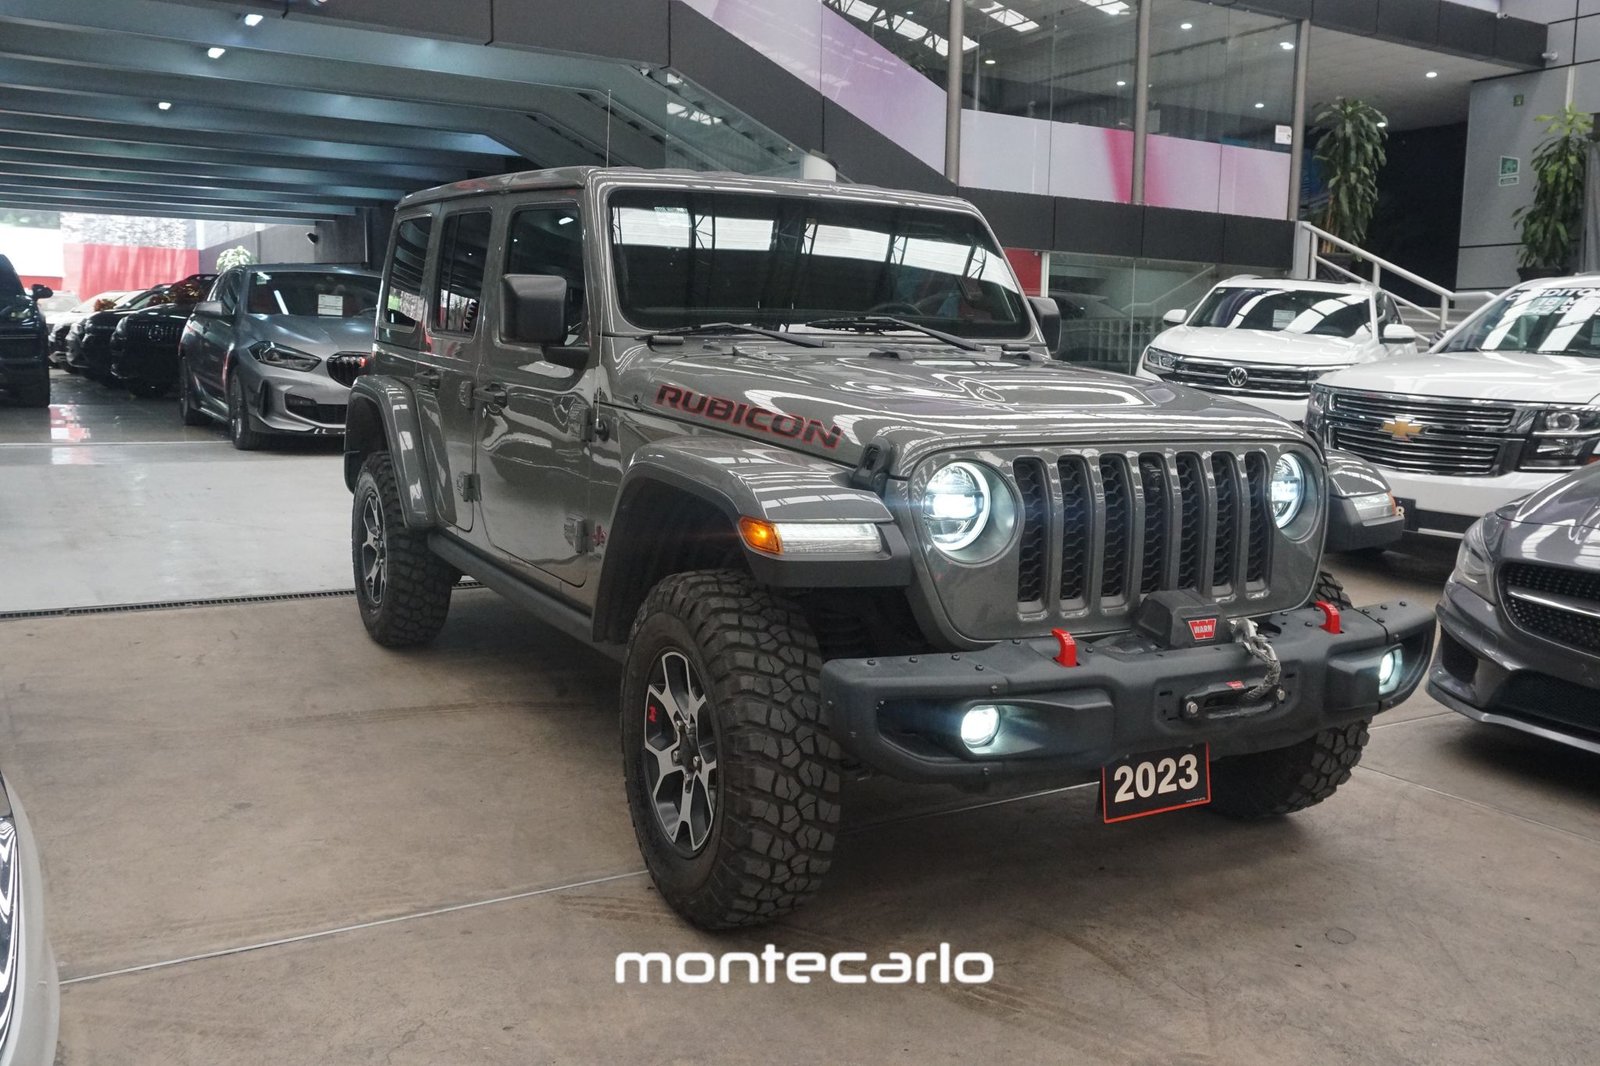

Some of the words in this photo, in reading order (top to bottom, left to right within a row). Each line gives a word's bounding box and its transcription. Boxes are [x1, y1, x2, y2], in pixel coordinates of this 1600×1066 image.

[656, 384, 843, 449] RUBICON
[1194, 624, 1213, 634] WARN
[1113, 753, 1199, 803] 2023
